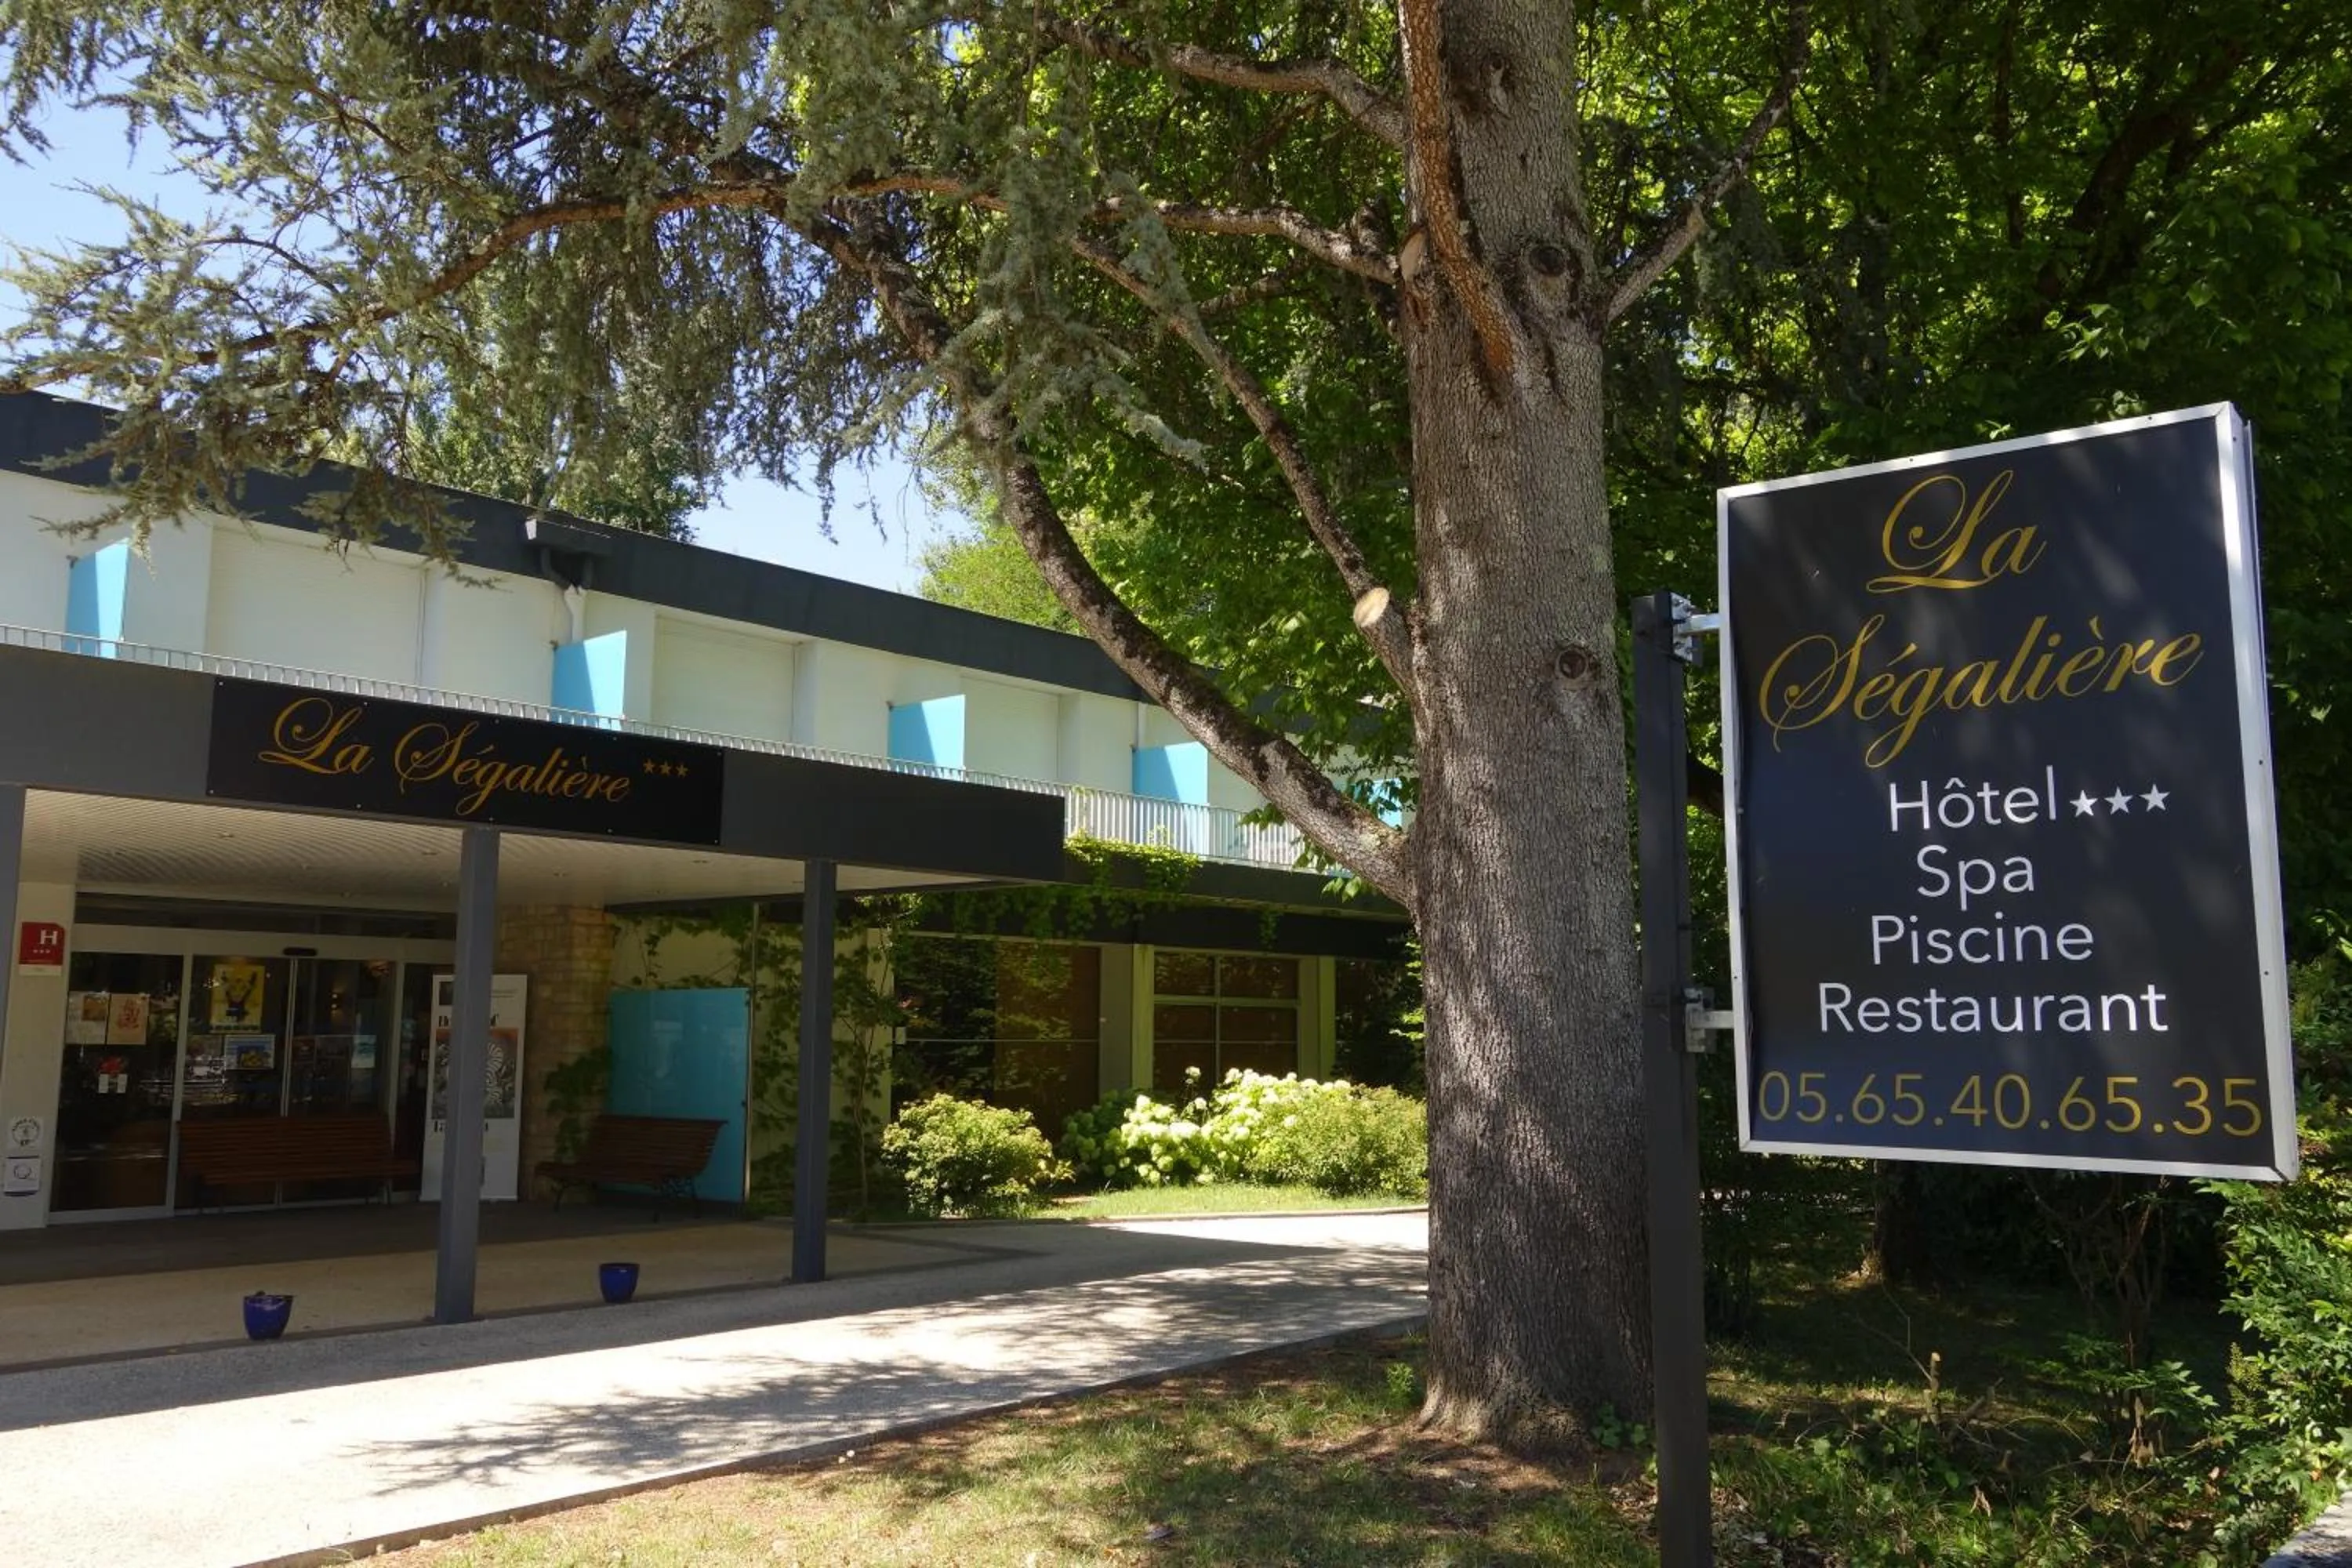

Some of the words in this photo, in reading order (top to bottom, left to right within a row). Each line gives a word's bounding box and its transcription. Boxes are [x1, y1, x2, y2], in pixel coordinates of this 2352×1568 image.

[1866, 470, 2047, 593] La
[1759, 614, 2204, 768] Ségalière
[258, 697, 375, 775] La
[394, 720, 631, 815] Ségalière
[1889, 765, 2057, 832] Hôtel
[1916, 844, 2035, 911] Spa
[1871, 911, 2094, 965] Piscine
[1819, 982, 2169, 1033] Restaurant
[1759, 1071, 2262, 1137] 05.65.40.65.35
